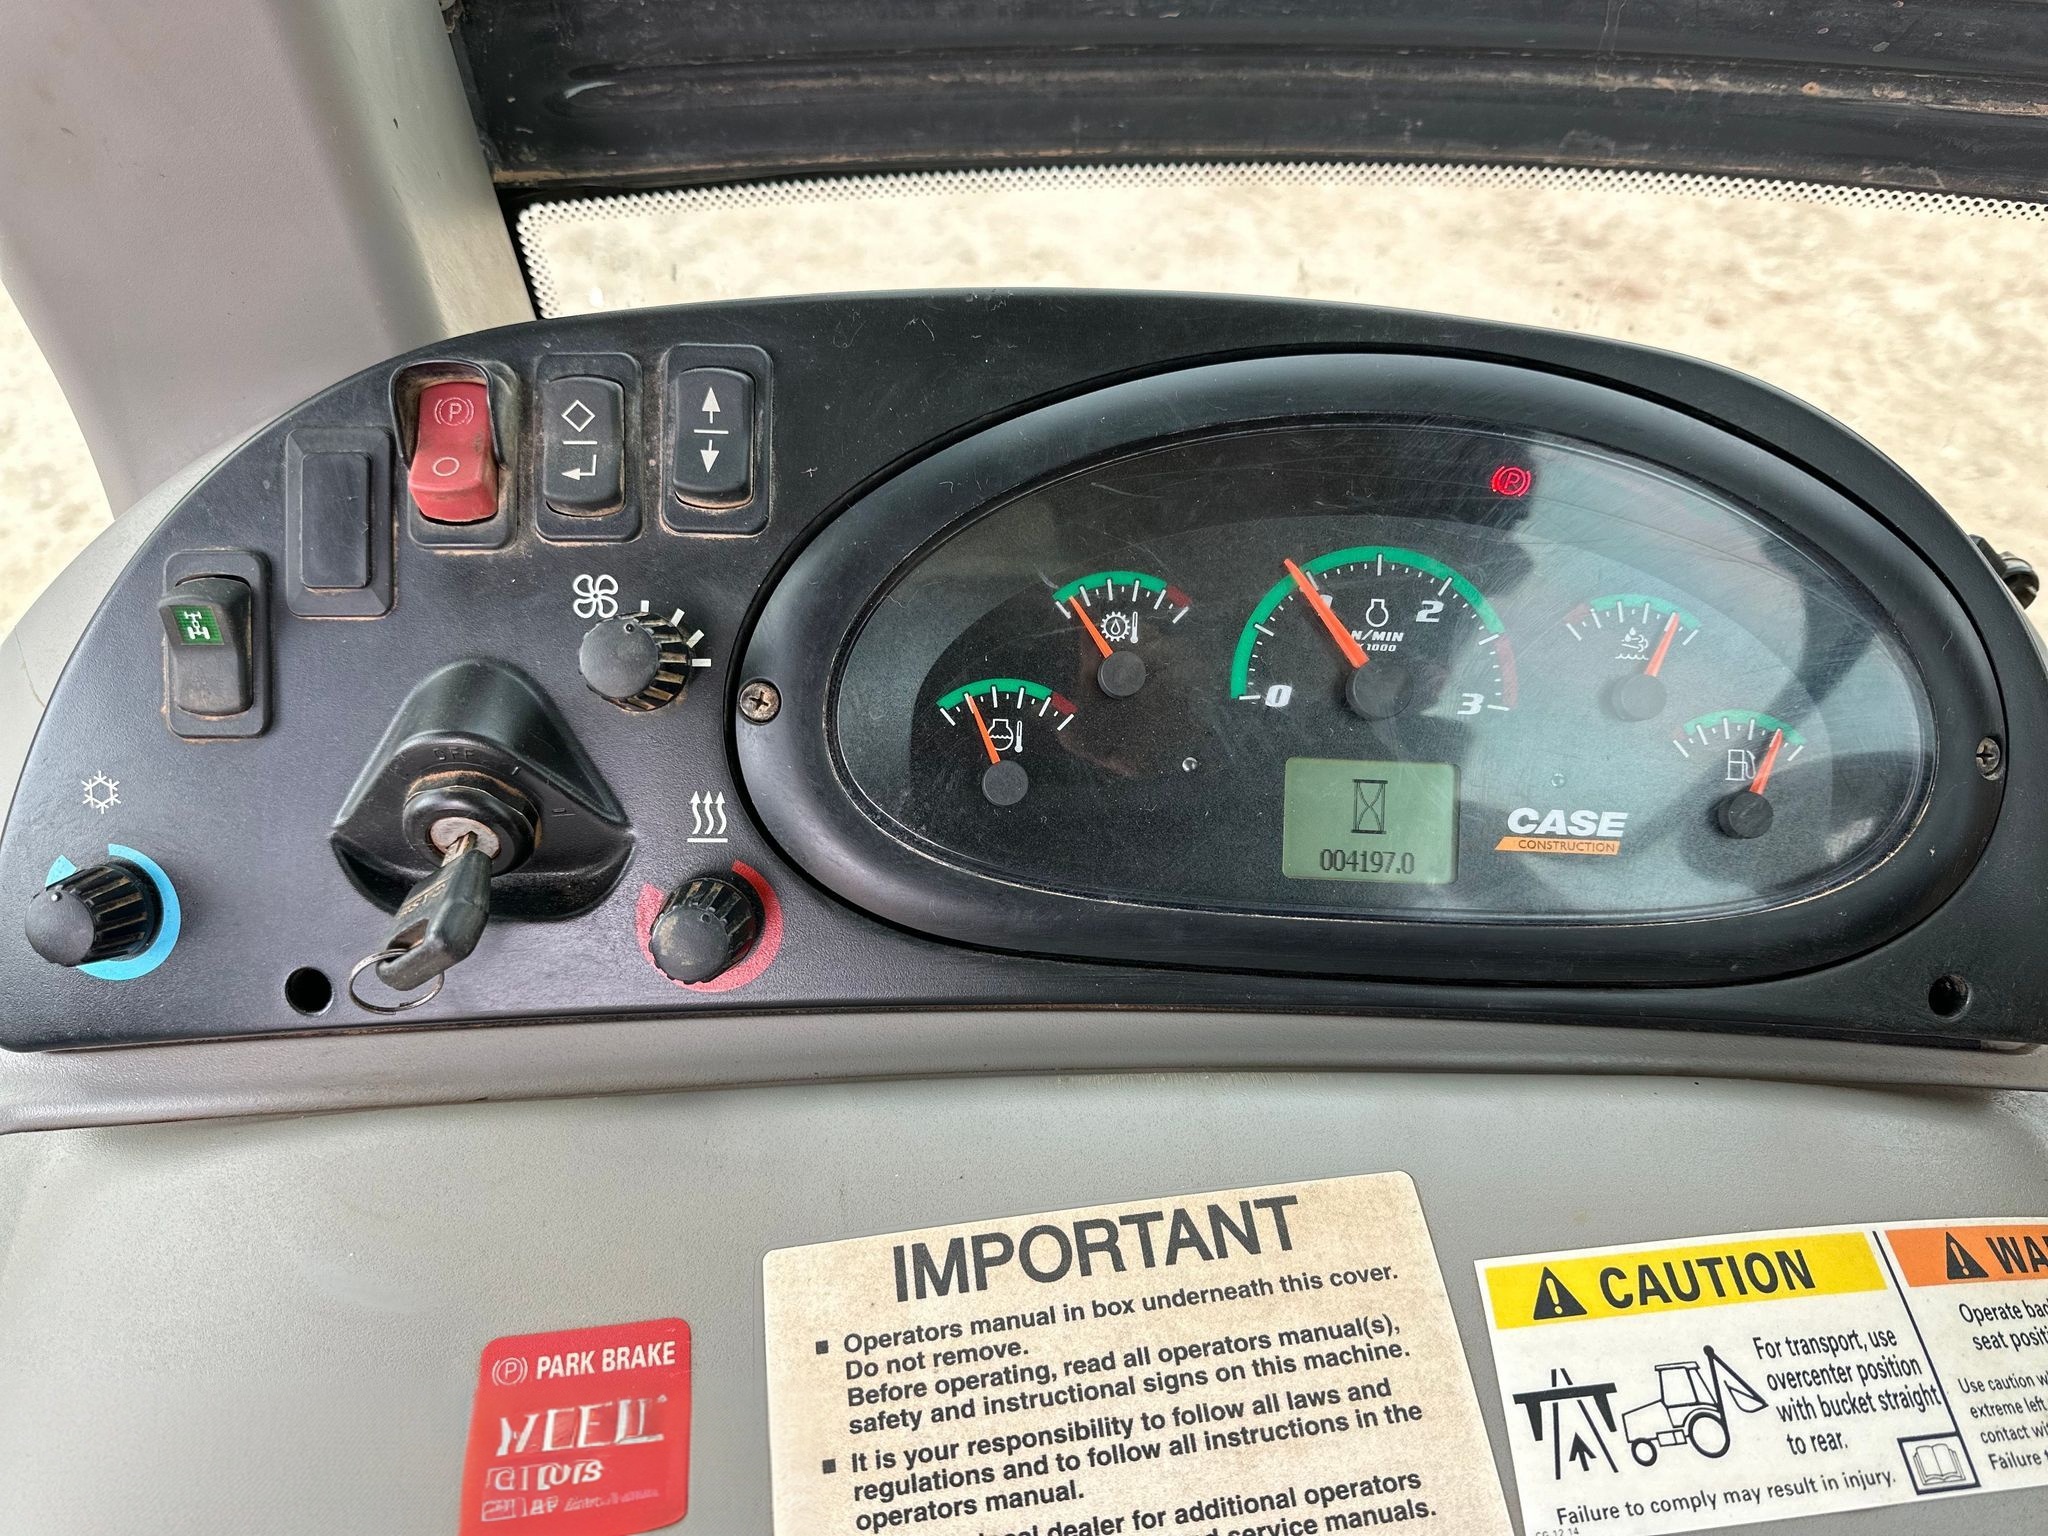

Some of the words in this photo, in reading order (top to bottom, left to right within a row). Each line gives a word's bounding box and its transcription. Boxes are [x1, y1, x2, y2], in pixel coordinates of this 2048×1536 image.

[1416, 600, 1443, 623] 2
[1265, 685, 1293, 708] 0
[1456, 693, 1485, 715] 3
[433, 748, 476, 761] OFF
[1507, 807, 1628, 837] CASE
[1319, 848, 1415, 874] 004197.0
[1518, 839, 1616, 853] CONSTRUCTION
[893, 1195, 1298, 1302] IMPORTANT
[1985, 1236, 2048, 1274] WA
[1600, 1248, 1816, 1309] CAUTION
[844, 1322, 963, 1355] Operators
[970, 1305, 1056, 1335] manual
[1063, 1303, 1085, 1323] in
[1092, 1299, 1136, 1319] box
[1142, 1279, 1273, 1311] underneath
[1279, 1272, 1323, 1294] this
[1329, 1264, 1398, 1287] cover.
[1959, 1303, 2023, 1327] Operate
[1752, 1336, 1782, 1360] For
[1785, 1330, 1867, 1359] transport,
[1868, 1328, 1897, 1348] use
[1972, 1331, 2009, 1351] seat
[536, 1350, 596, 1380] PARK
[602, 1341, 676, 1373] BRAKE
[846, 1359, 879, 1380] Do
[887, 1353, 926, 1374] not
[933, 1340, 1029, 1368] remove.
[848, 1380, 928, 1407] Before
[934, 1364, 1058, 1397] operating,
[1063, 1351, 1116, 1377] read
[1124, 1347, 1150, 1368] all
[1158, 1332, 1272, 1366] operators
[1278, 1314, 1400, 1347] manual(s),
[1766, 1366, 1853, 1391] overcenter
[1856, 1355, 1922, 1386] position
[849, 1409, 923, 1434] safety
[931, 1399, 976, 1423] and
[983, 1376, 1135, 1416] instructional
[1143, 1368, 1209, 1395] signs
[1216, 1363, 1246, 1383] on
[1252, 1355, 1297, 1378] this
[1304, 1343, 1410, 1370] machine.
[1957, 1377, 1985, 1394] Use
[1988, 1373, 2035, 1391] caution
[1775, 1398, 1818, 1423] with
[1817, 1391, 1877, 1419] bucket
[1877, 1383, 1942, 1413] straight
[1970, 1402, 2024, 1419] extreme
[2023, 1395, 2047, 1413] left
[852, 1453, 868, 1473] It
[875, 1450, 896, 1470] is
[904, 1443, 959, 1470] your
[967, 1416, 1133, 1456] responsibility
[1141, 1411, 1166, 1431] to
[1172, 1402, 1244, 1427] follow
[1252, 1393, 1280, 1415] all
[1286, 1388, 1341, 1411] laws
[1348, 1377, 1392, 1401] and
[1980, 1424, 2031, 1444] contact
[854, 1468, 995, 1503] regulations
[1003, 1455, 1049, 1480] and
[1056, 1453, 1081, 1472] to
[1087, 1441, 1161, 1467] follow
[1169, 1433, 1197, 1456] all
[1204, 1414, 1350, 1450] instructions
[1355, 1409, 1379, 1429] in
[1383, 1403, 1423, 1424] the
[1786, 1433, 1806, 1456] to
[1810, 1431, 1848, 1452] rear.
[1987, 1451, 2042, 1470] Failure
[856, 1498, 977, 1534] operators
[985, 1479, 1084, 1512] manual.
[1047, 1515, 1125, 1536] dealer
[1132, 1509, 1167, 1531] for
[1174, 1487, 1297, 1525] additional
[1304, 1472, 1422, 1509] operators
[1556, 1505, 1620, 1525] Failure
[1625, 1500, 1645, 1517] to
[1650, 1490, 1717, 1514] comply
[1723, 1487, 1761, 1506] may
[1766, 1477, 1818, 1499] result
[1821, 1474, 1840, 1491] in
[1842, 1468, 1897, 1490] injury.
[1325, 1498, 1436, 1533] manuals.
